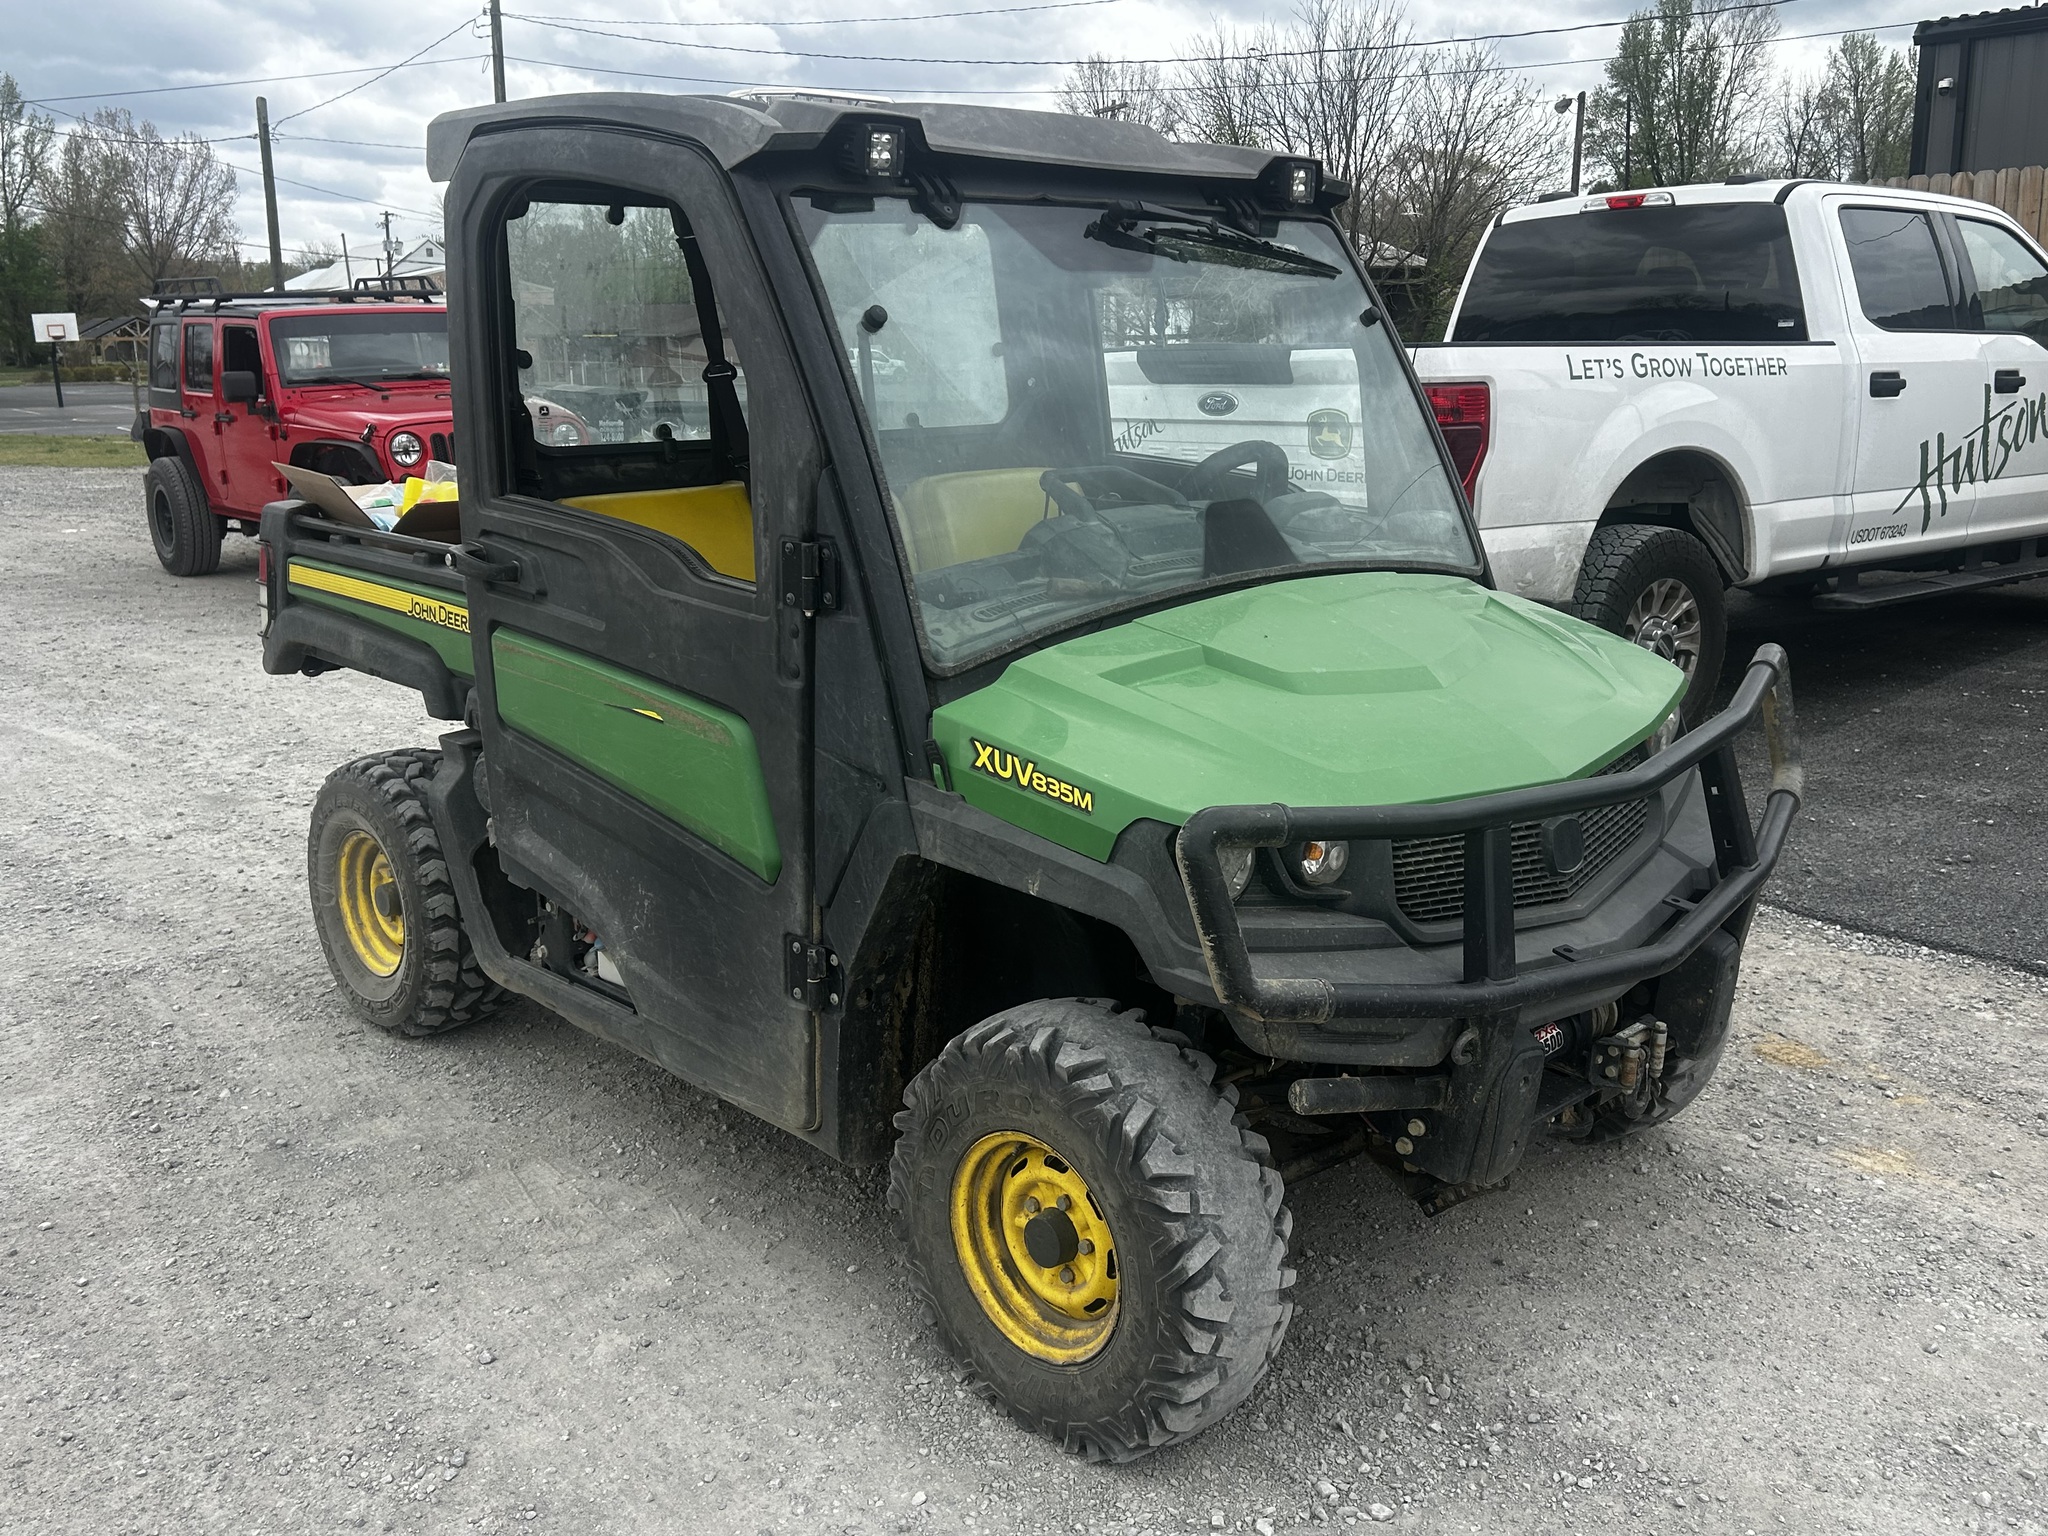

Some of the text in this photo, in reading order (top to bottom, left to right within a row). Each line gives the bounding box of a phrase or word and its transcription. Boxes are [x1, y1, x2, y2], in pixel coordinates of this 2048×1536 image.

[1566, 352, 1788, 380] LET'S GROW TOGETHER
[1205, 396, 1227, 410] Ford
[1113, 418, 1166, 451] utson
[1892, 383, 2048, 536] Hutson
[1288, 467, 1364, 484] JOHN DEER
[1851, 523, 1908, 544] USDOT 673243
[408, 598, 468, 630] JOHN DEER
[1536, 1022, 1558, 1041] ZXR
[1541, 1031, 1564, 1056] 500
